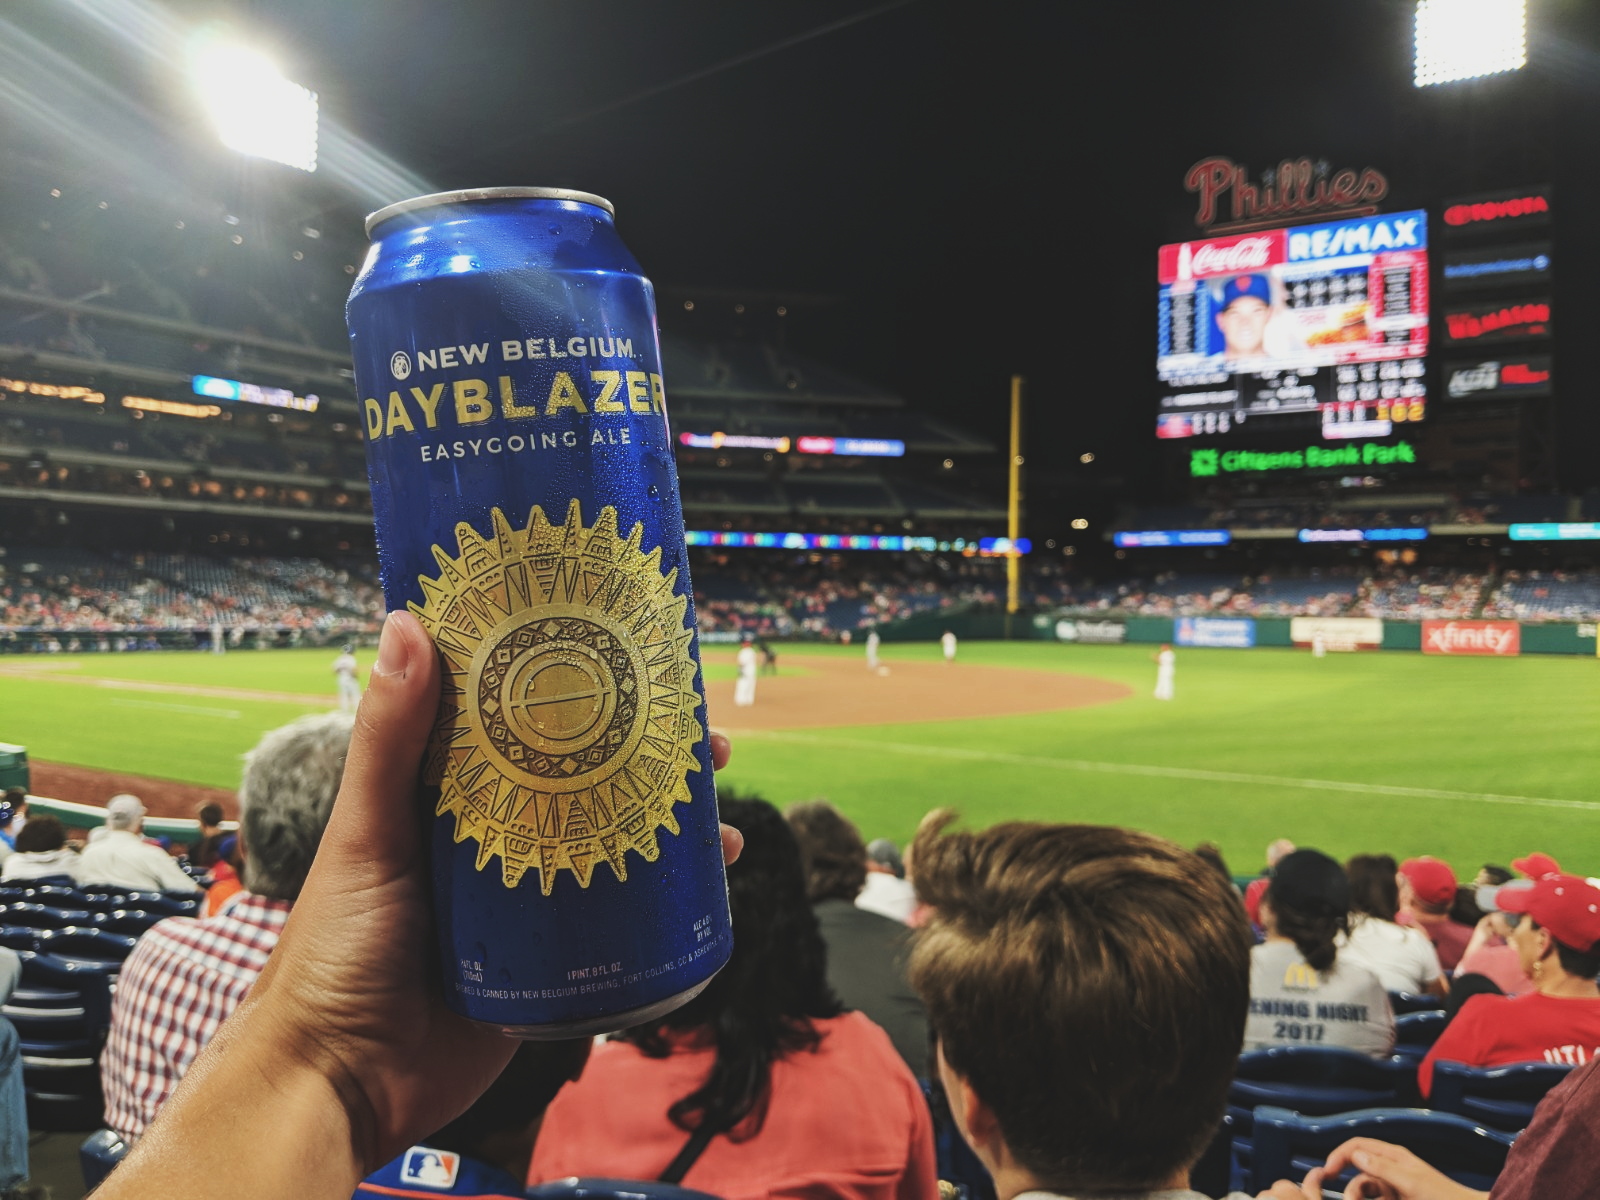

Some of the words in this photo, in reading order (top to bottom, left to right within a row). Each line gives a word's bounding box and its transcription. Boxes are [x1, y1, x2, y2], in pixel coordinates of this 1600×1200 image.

[1184, 156, 1388, 227] Phillies
[1288, 217, 1421, 262] RE/MAX
[417, 342, 490, 372] NEW
[502, 337, 634, 361] BELGIUM
[364, 370, 664, 441] DAYBLAZER
[421, 431, 577, 462] EASYGOING
[591, 428, 631, 446] ALE
[1221, 450, 1304, 472] Citizens
[1306, 443, 1360, 467] Bank
[1363, 441, 1416, 466] Park
[1428, 620, 1514, 654] xfinity
[482, 988, 509, 999] CANNED
[510, 990, 520, 999] BY
[522, 989, 539, 999] NEW
[541, 986, 577, 998] BELGIUM
[580, 978, 621, 994] BREWING,
[623, 972, 642, 984] FORT
[645, 961, 677, 979] COLLINS,
[1316, 1002, 1368, 1022] NIGHT
[1274, 1021, 1325, 1040] 2017
